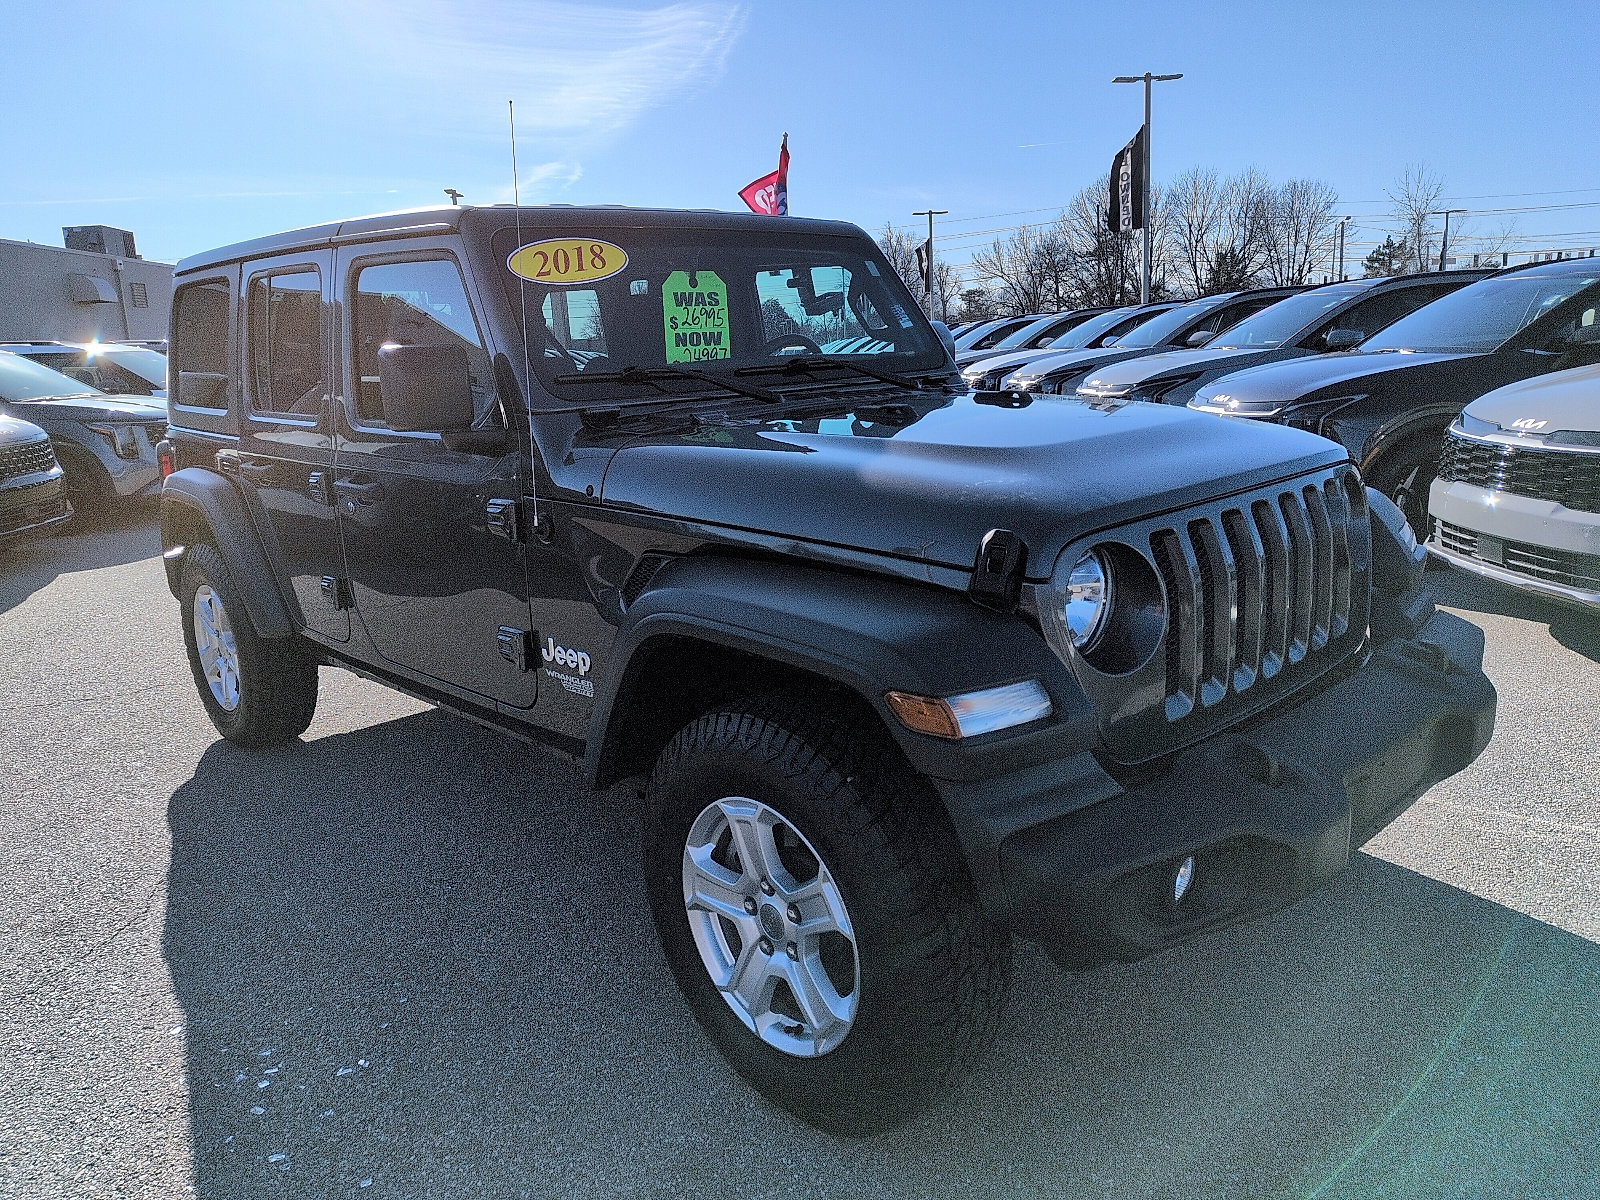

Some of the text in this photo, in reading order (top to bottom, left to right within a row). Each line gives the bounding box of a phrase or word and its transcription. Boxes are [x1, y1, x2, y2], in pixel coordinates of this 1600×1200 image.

[532, 244, 607, 278] 2018
[672, 291, 720, 307] WAS
[674, 331, 722, 347] NOW
[541, 637, 591, 676] Jeep
